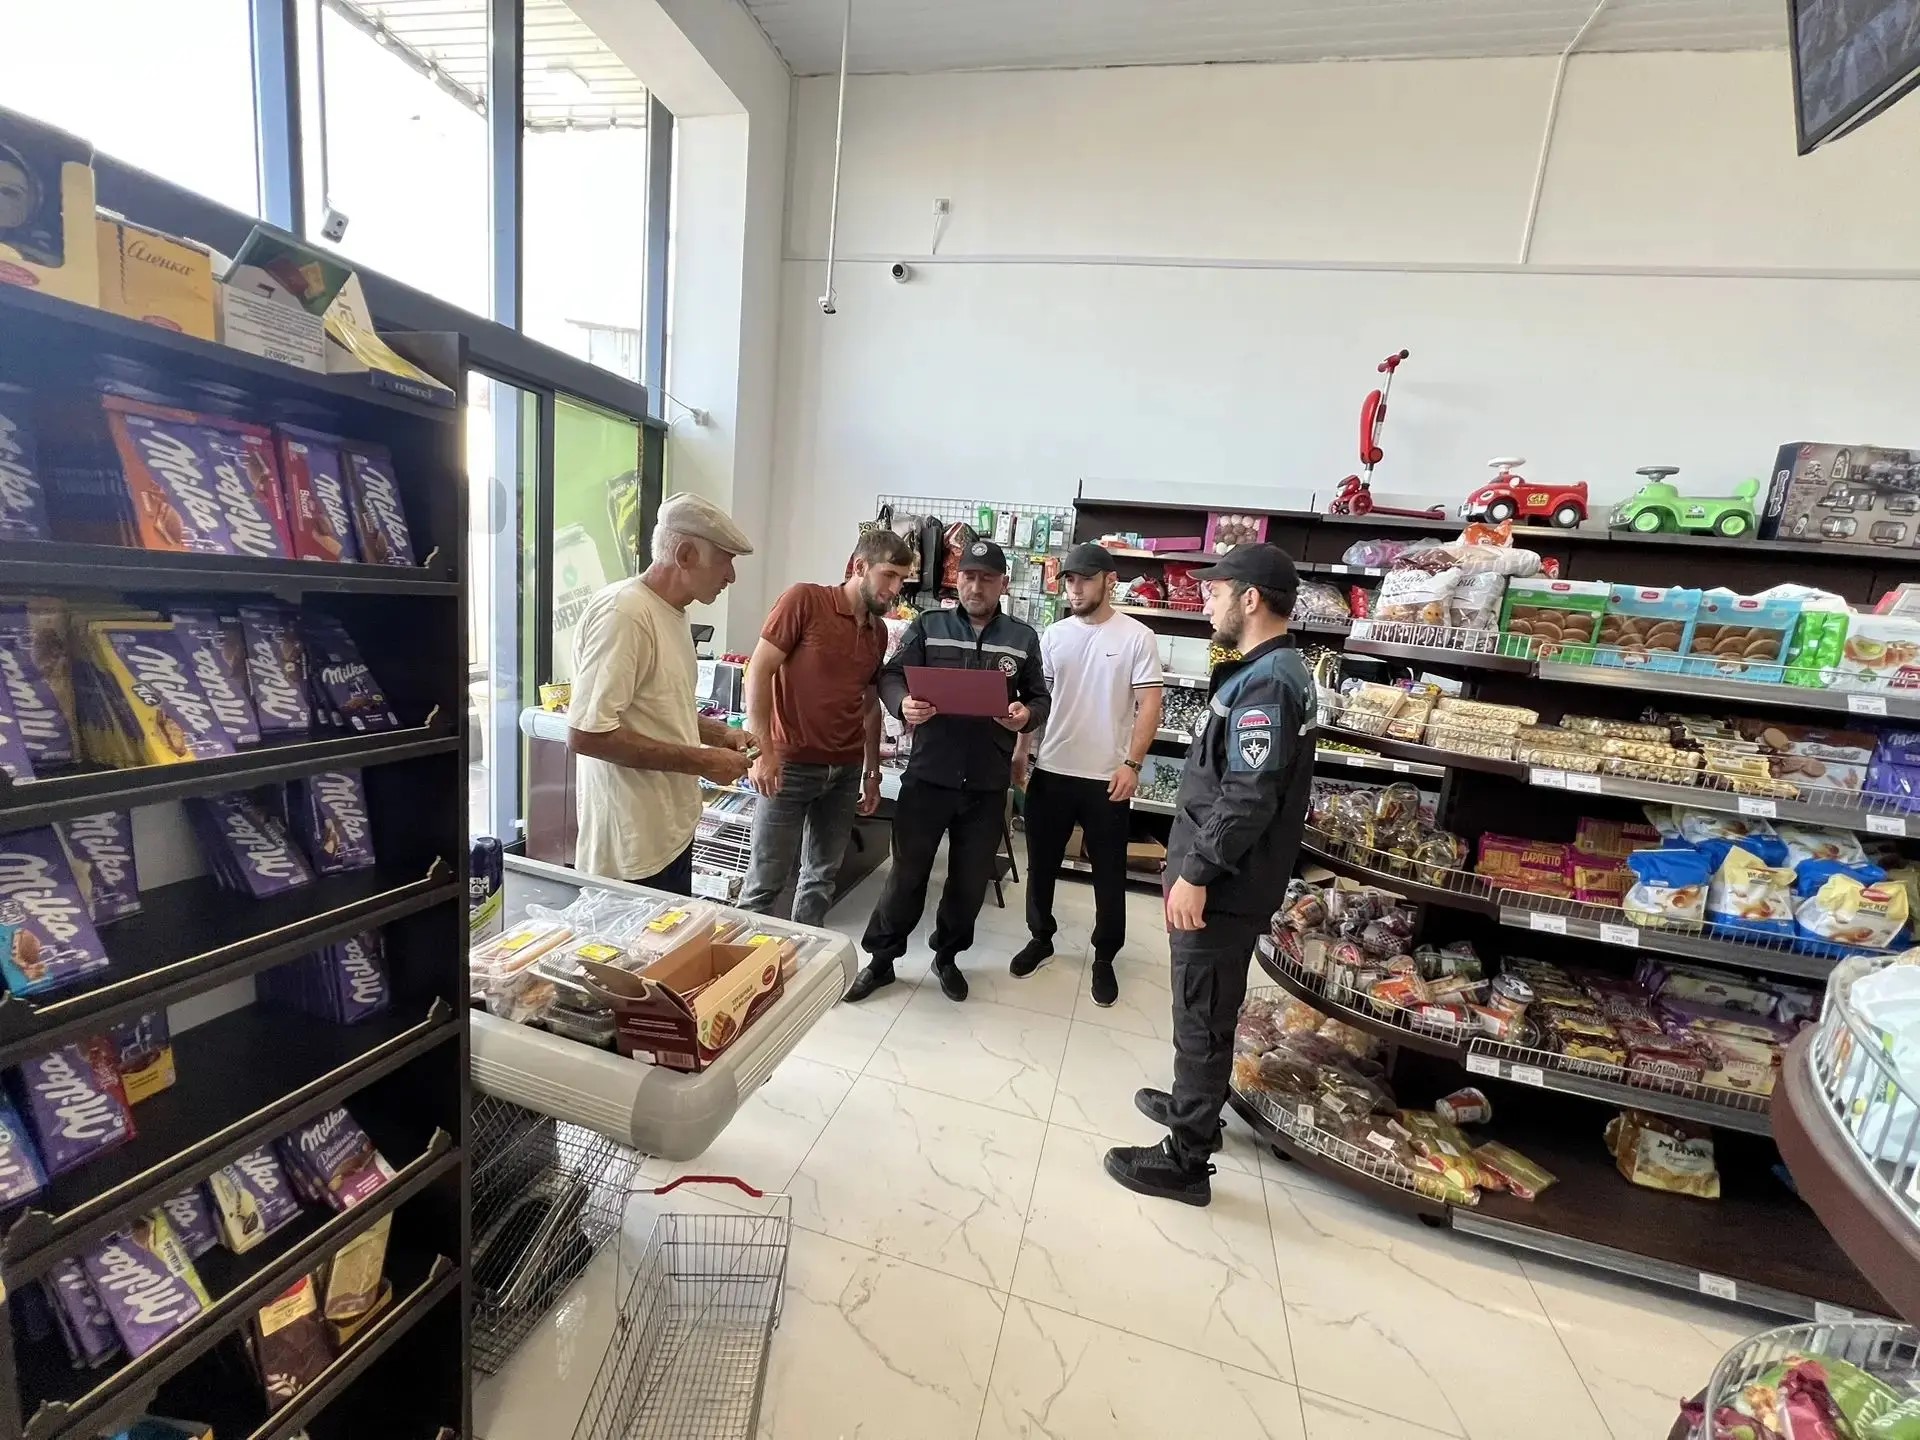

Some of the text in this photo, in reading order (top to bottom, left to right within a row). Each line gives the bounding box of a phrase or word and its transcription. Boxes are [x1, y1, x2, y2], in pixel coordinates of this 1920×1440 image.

[126, 240, 195, 278] Аленка
[395, 382, 433, 400] merci
[140, 430, 221, 532] Milka
[214, 461, 277, 557] Milka
[314, 473, 349, 537] Milka
[360, 466, 409, 551] Milka
[127, 645, 212, 734] Milka
[192, 645, 249, 734] Milka
[248, 638, 301, 720] Milka
[322, 662, 369, 686] Milka
[226, 813, 295, 877] Milka
[317, 773, 368, 843] Milka
[71, 811, 131, 886] Milka
[0, 853, 81, 943] Milka
[344, 938, 383, 1004] Milka
[35, 1052, 114, 1139] Milka
[301, 1108, 348, 1152] Milka
[234, 1145, 279, 1194] ilka
[98, 1246, 185, 1324] Milka
